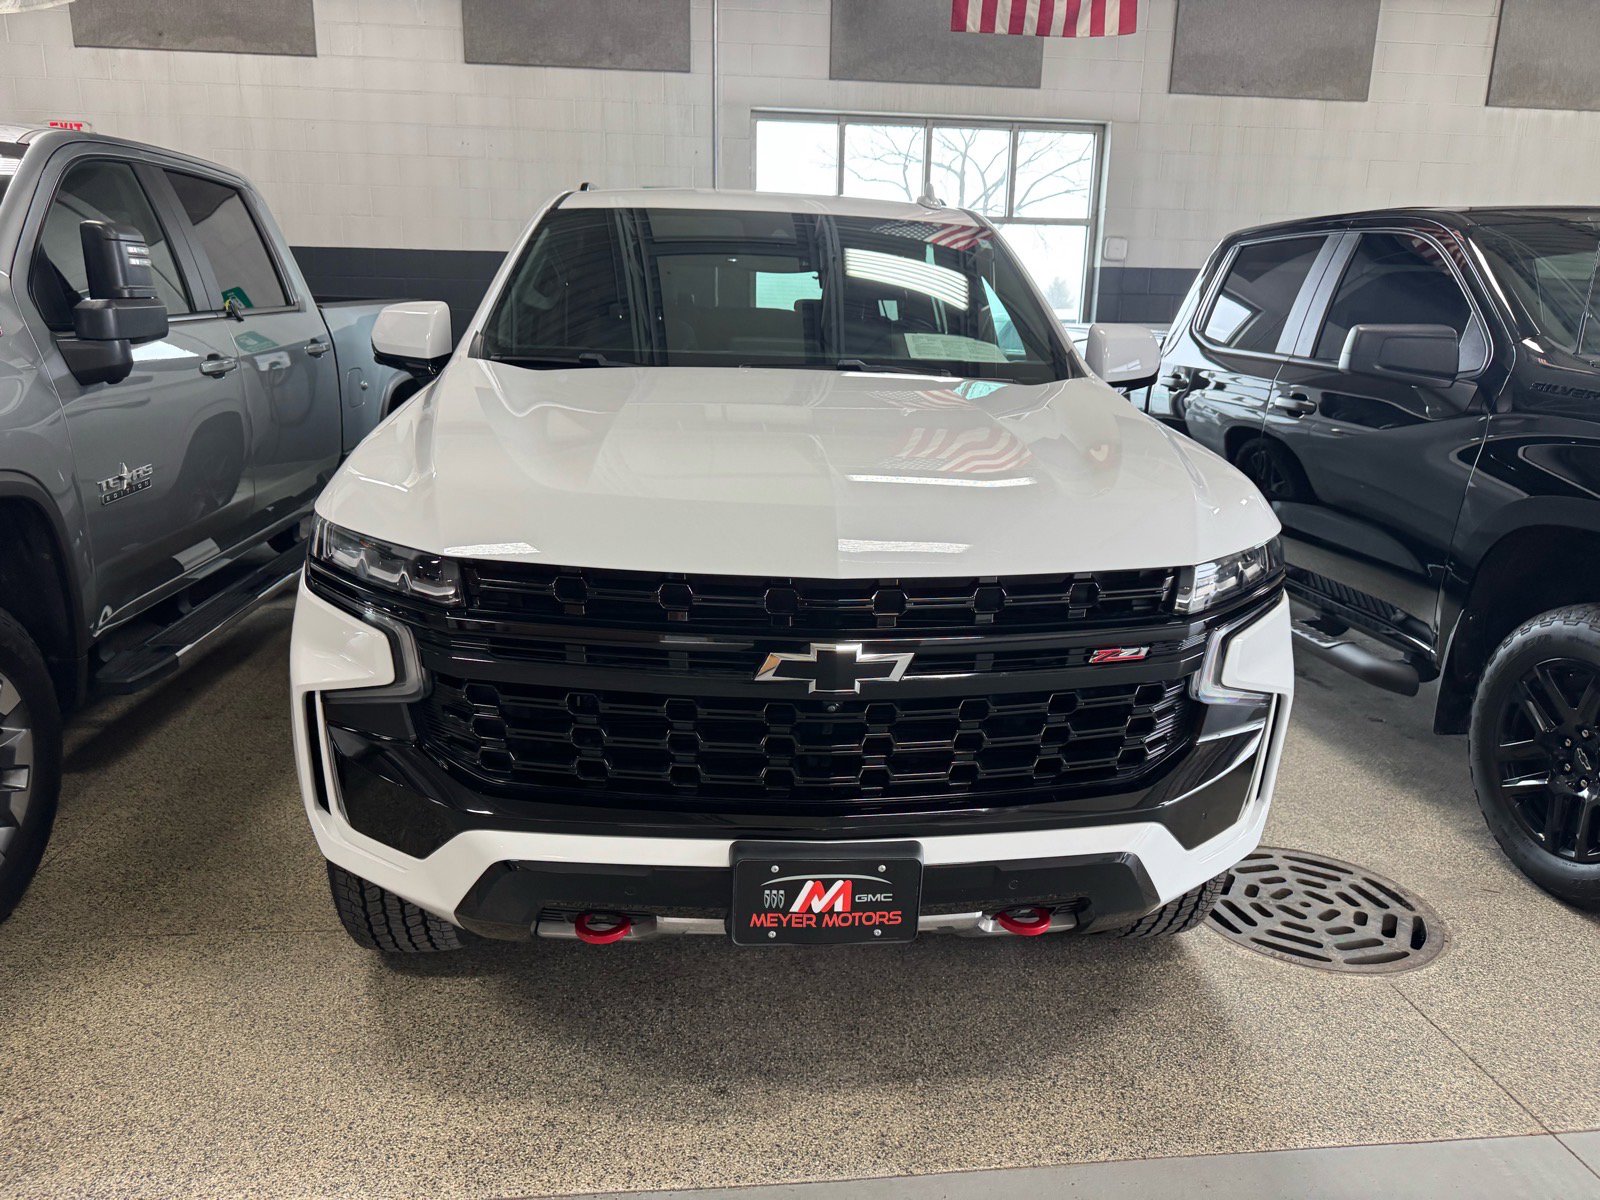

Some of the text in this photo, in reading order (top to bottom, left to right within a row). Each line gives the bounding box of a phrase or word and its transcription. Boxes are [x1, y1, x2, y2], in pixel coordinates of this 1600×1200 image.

[105, 481, 150, 502] EDITION
[1088, 647, 1150, 663] Z71
[855, 893, 893, 902] GMC
[750, 911, 902, 928] MEYER MOTORS
